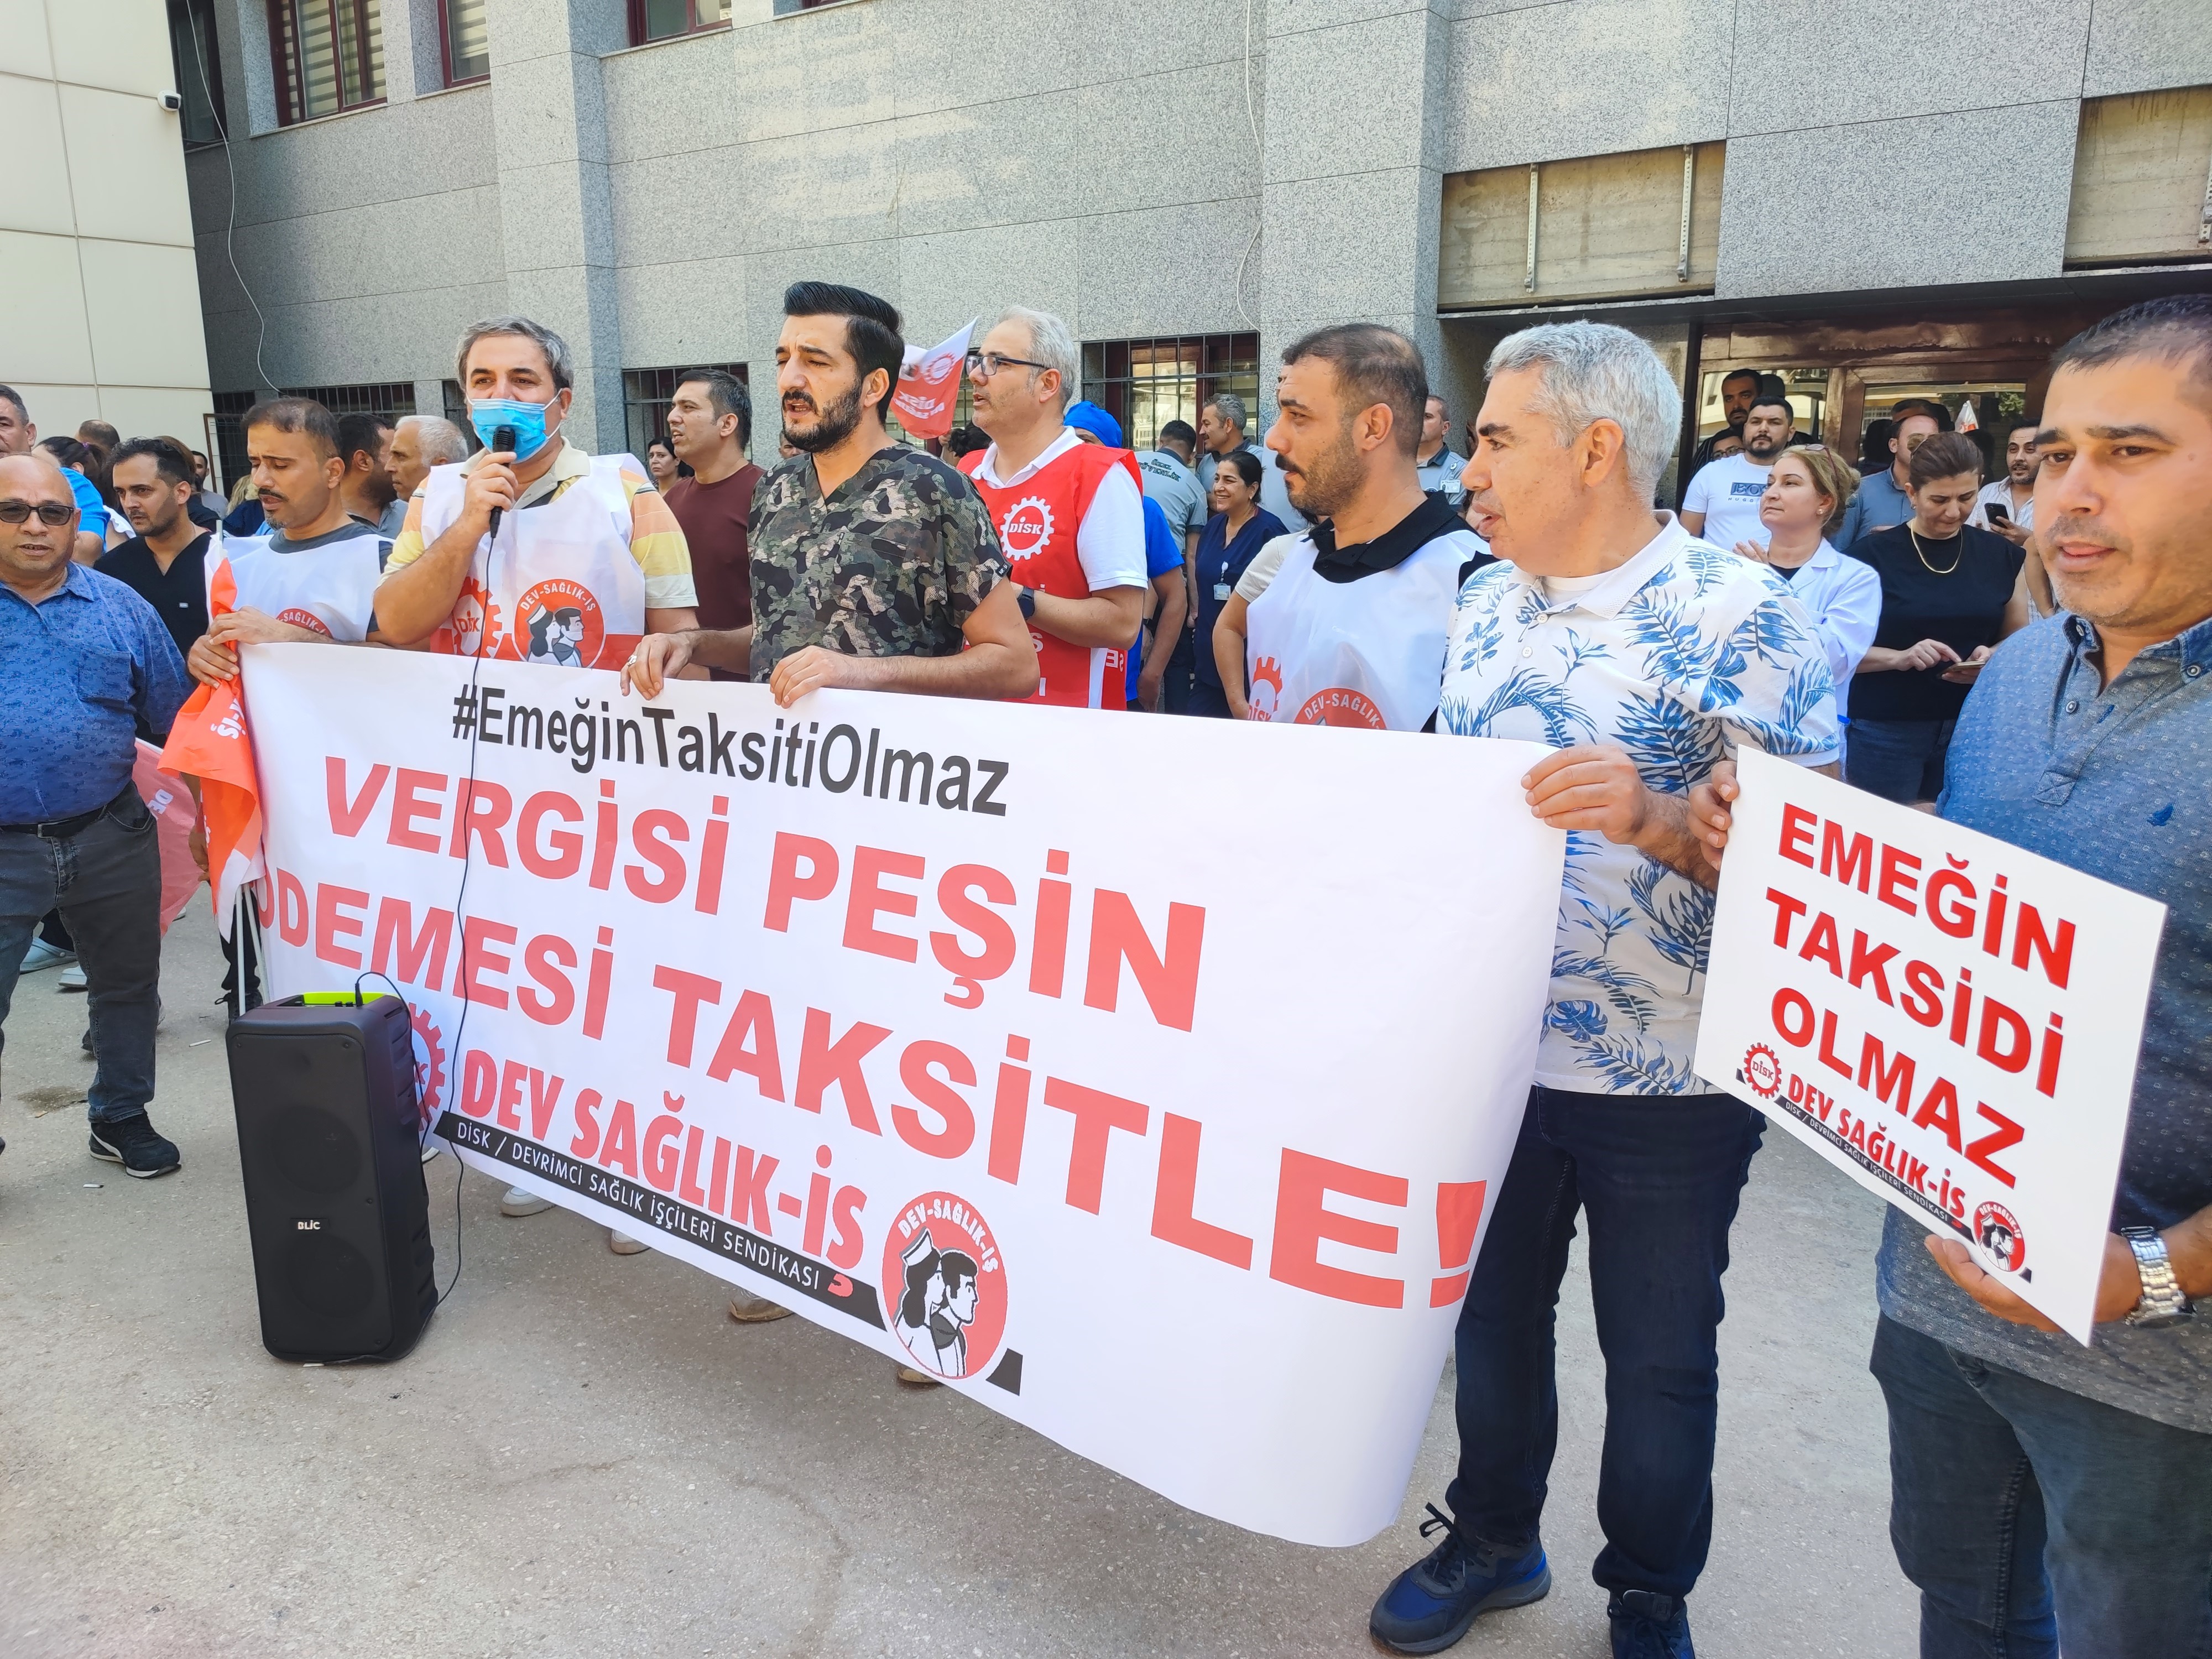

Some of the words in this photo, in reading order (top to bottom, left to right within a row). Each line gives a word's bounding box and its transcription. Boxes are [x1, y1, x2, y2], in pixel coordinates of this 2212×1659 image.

[1008, 516, 1043, 535] DİSK
[1731, 484, 1767, 495] BO
[452, 683, 1009, 817] #EmeğinTaksitiOlmaz
[1303, 693, 1380, 729] DEV-SAĞLIK-
[325, 756, 729, 916] VERGİSİ
[763, 831, 1206, 1033] PEŞİN
[1778, 802, 2077, 990] EMEĞİN
[1765, 886, 2065, 1098] TAKSİDİ
[460, 1049, 565, 1141] DEV
[653, 964, 1488, 1310] TAKSİTLE!
[1752, 1060, 1774, 1081] DİSK
[1771, 987, 2026, 1190] OLMAZ
[1788, 1073, 1834, 1123] DEV
[458, 1122, 491, 1149] DİSK
[512, 1142, 583, 1186] DEVRİMCİ
[589, 1173, 645, 1212] SAĞLIK
[650, 1194, 717, 1243] İŞÇİLERİ
[723, 1230, 820, 1285] SENDİKASI
